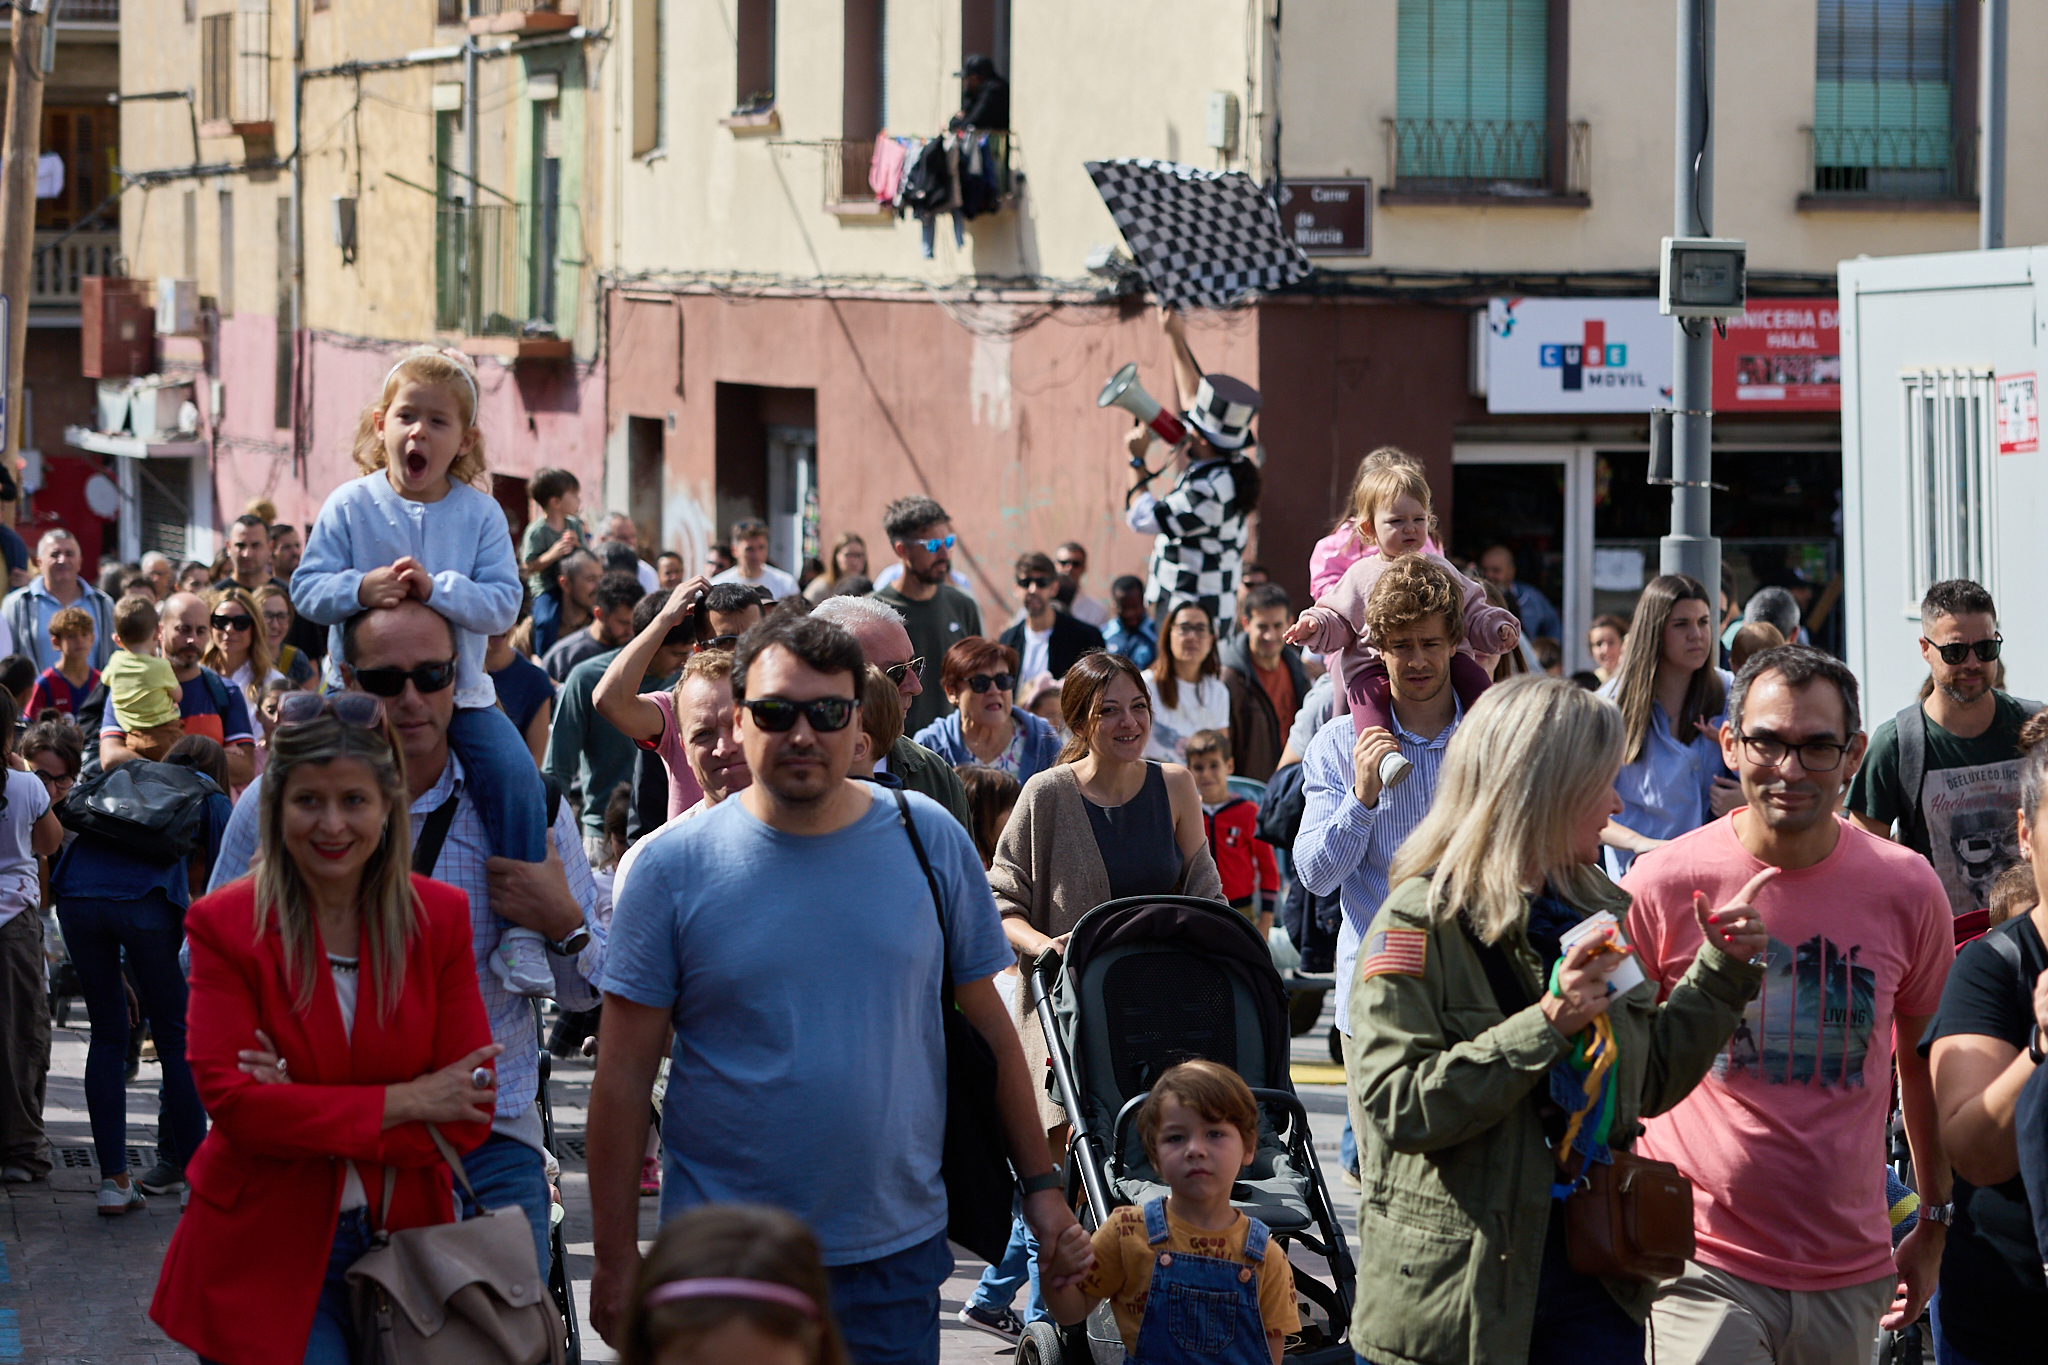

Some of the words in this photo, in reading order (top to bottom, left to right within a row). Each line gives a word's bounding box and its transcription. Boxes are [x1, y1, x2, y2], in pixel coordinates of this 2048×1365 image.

[1311, 186, 1349, 202] Carrer
[1295, 211, 1315, 227] de
[1766, 331, 1818, 349] HALAL
[1543, 346, 1623, 366] CUBE
[1946, 771, 1987, 790] DEELUXE
[1931, 792, 1988, 813] Hackney
[1823, 1009, 1867, 1024] LIVING
[1190, 1237, 1226, 1249] GOOD
